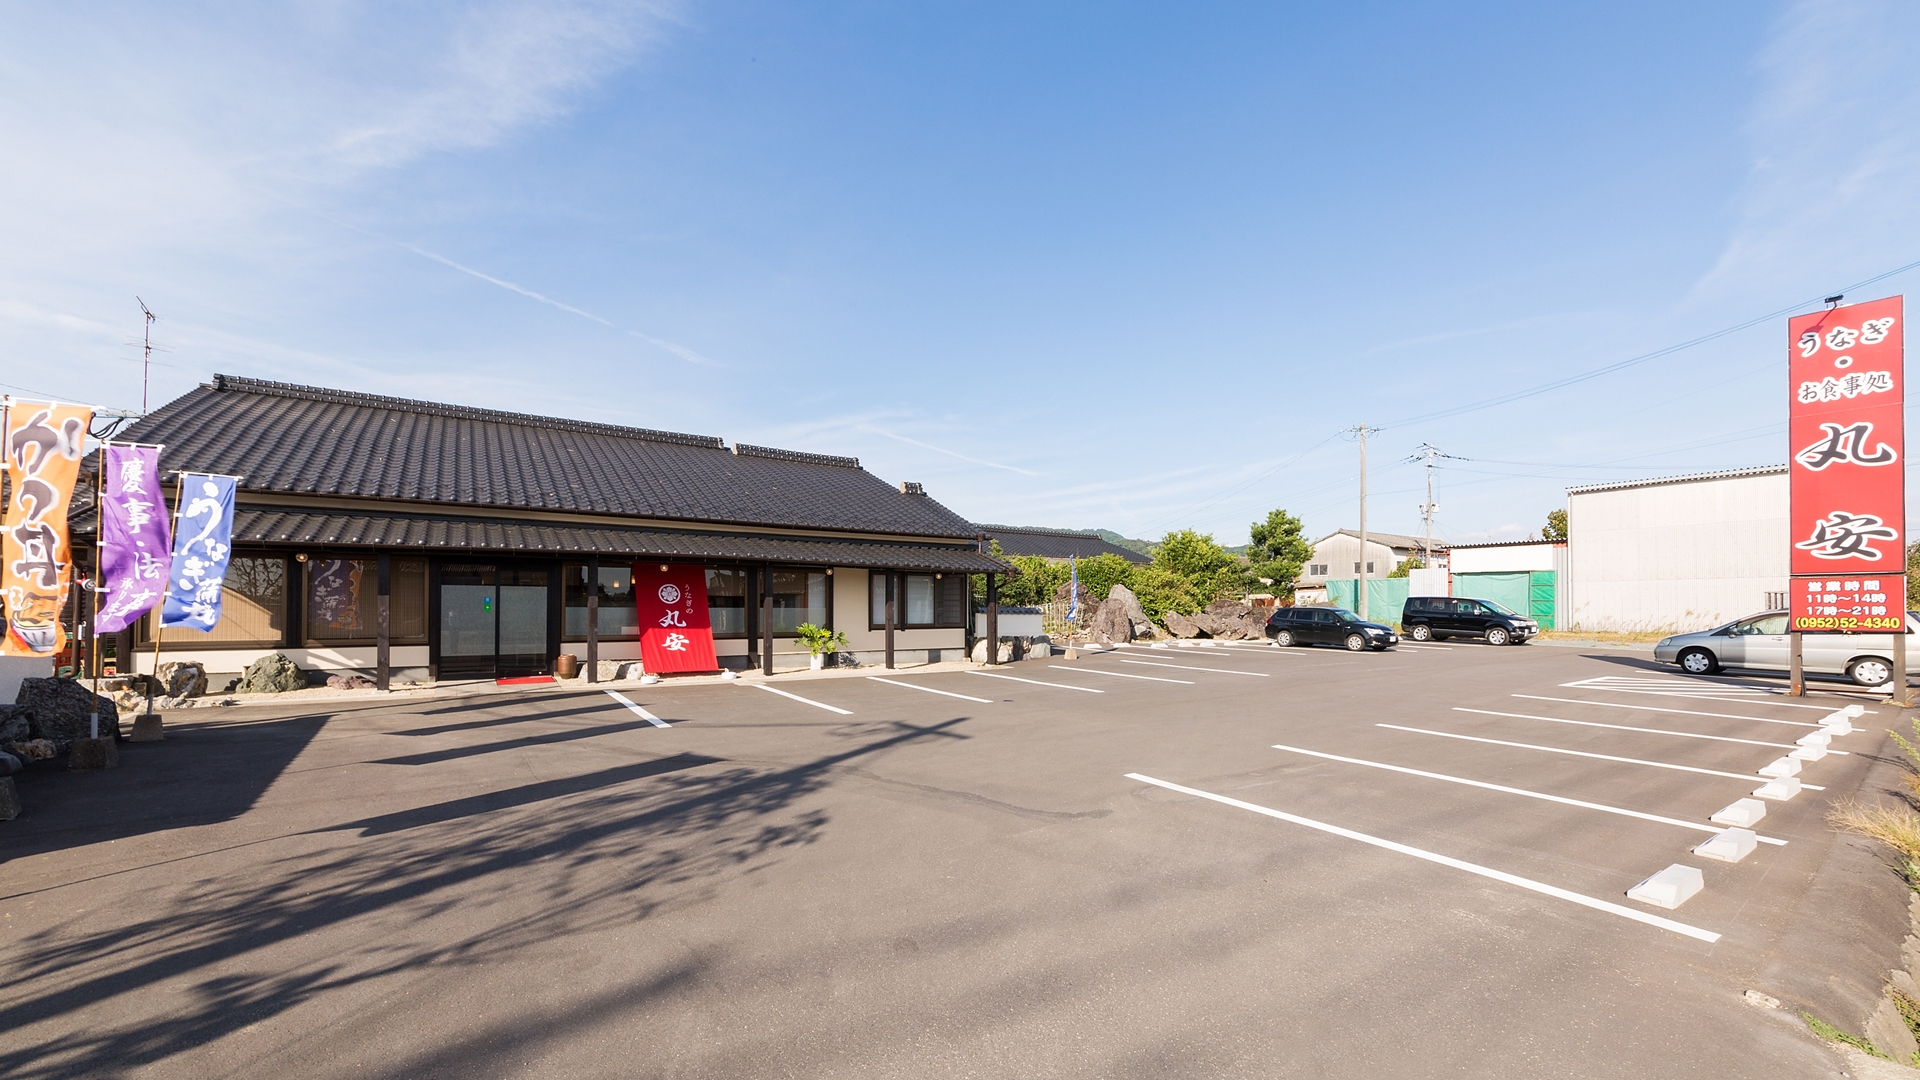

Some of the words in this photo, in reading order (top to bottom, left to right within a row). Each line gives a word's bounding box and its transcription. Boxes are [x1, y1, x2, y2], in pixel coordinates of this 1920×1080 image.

[1798, 317, 1894, 357] うなぎ
[1798, 371, 1893, 403] お食事処
[1795, 422, 1898, 561] 丸安
[684, 584, 694, 614] うなぎの
[1808, 580, 1880, 591] 営業時間
[659, 609, 689, 651] 丸安
[1795, 617, 1900, 629] (0952)52-4340
